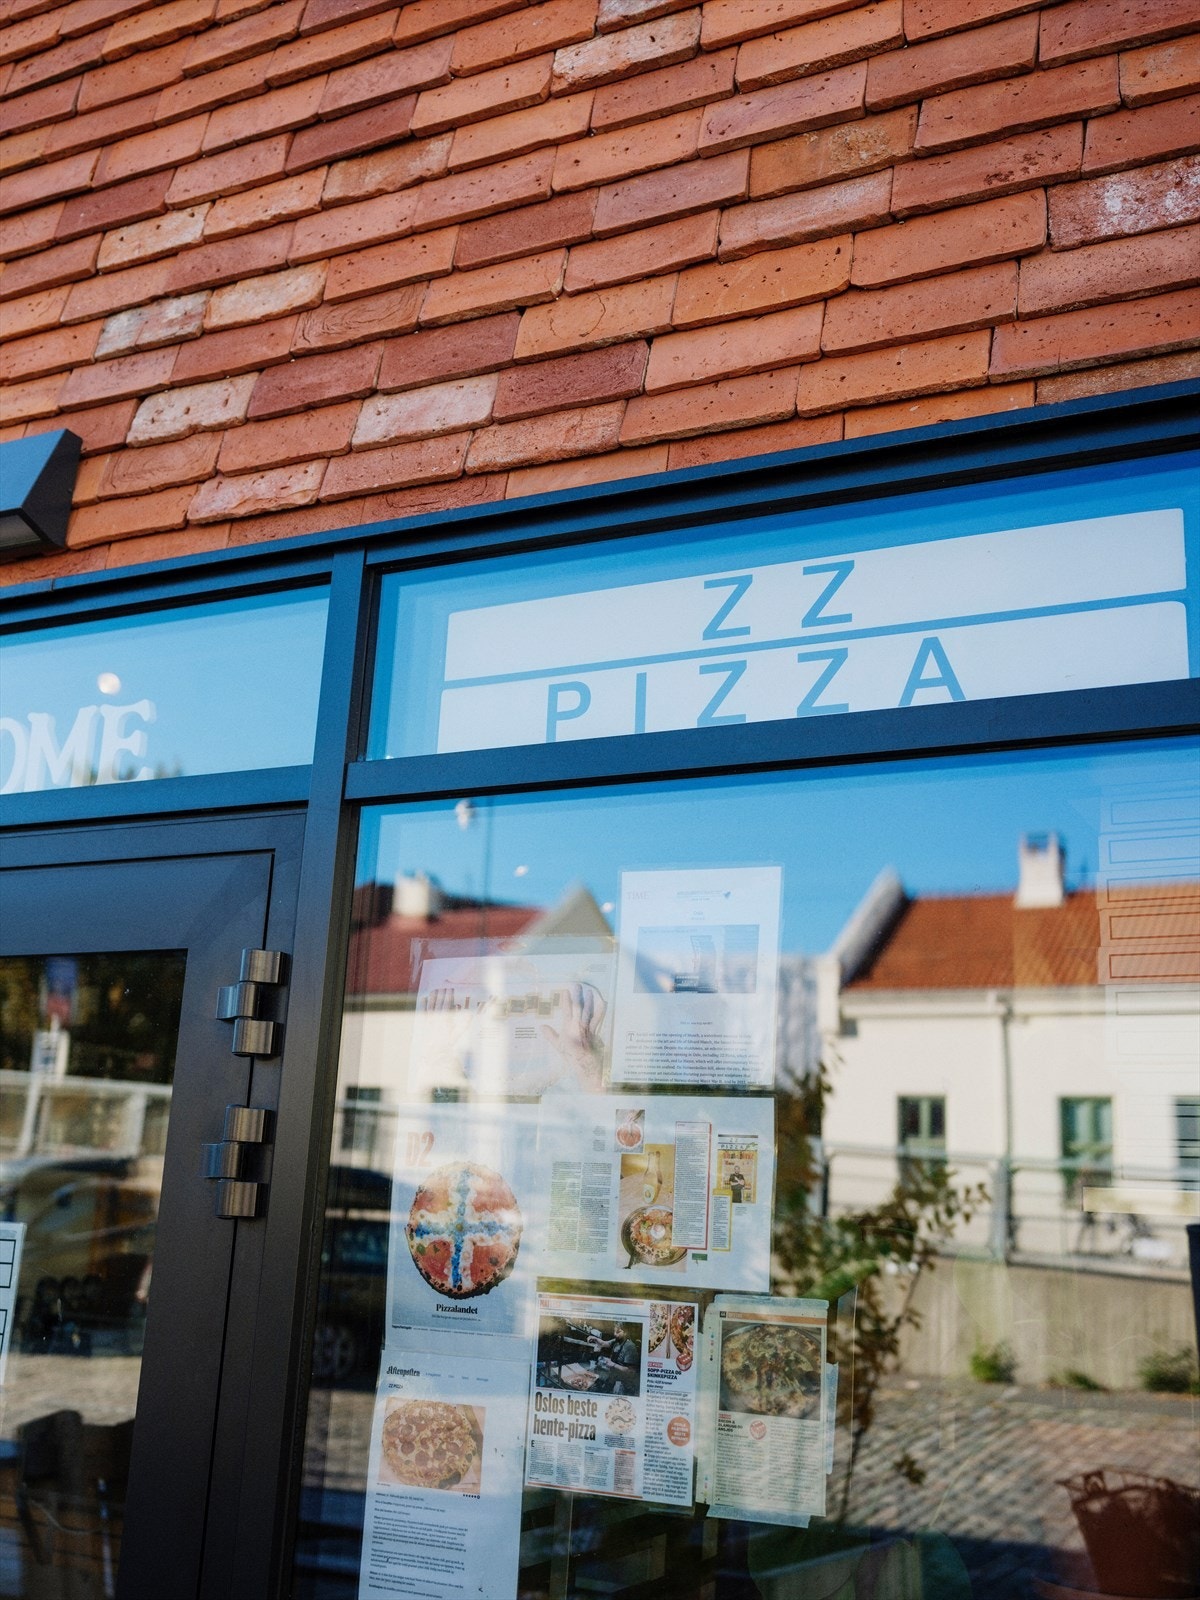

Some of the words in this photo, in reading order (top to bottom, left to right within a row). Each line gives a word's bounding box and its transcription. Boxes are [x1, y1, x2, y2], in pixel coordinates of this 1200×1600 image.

[547, 636, 967, 743] PIZZA
[436, 1303, 478, 1314] Pizzalandet
[386, 1366, 420, 1377] Aftenposten
[535, 1391, 565, 1414] Oslos
[567, 1394, 598, 1418] beste
[533, 1414, 596, 1442] hente-pizza
